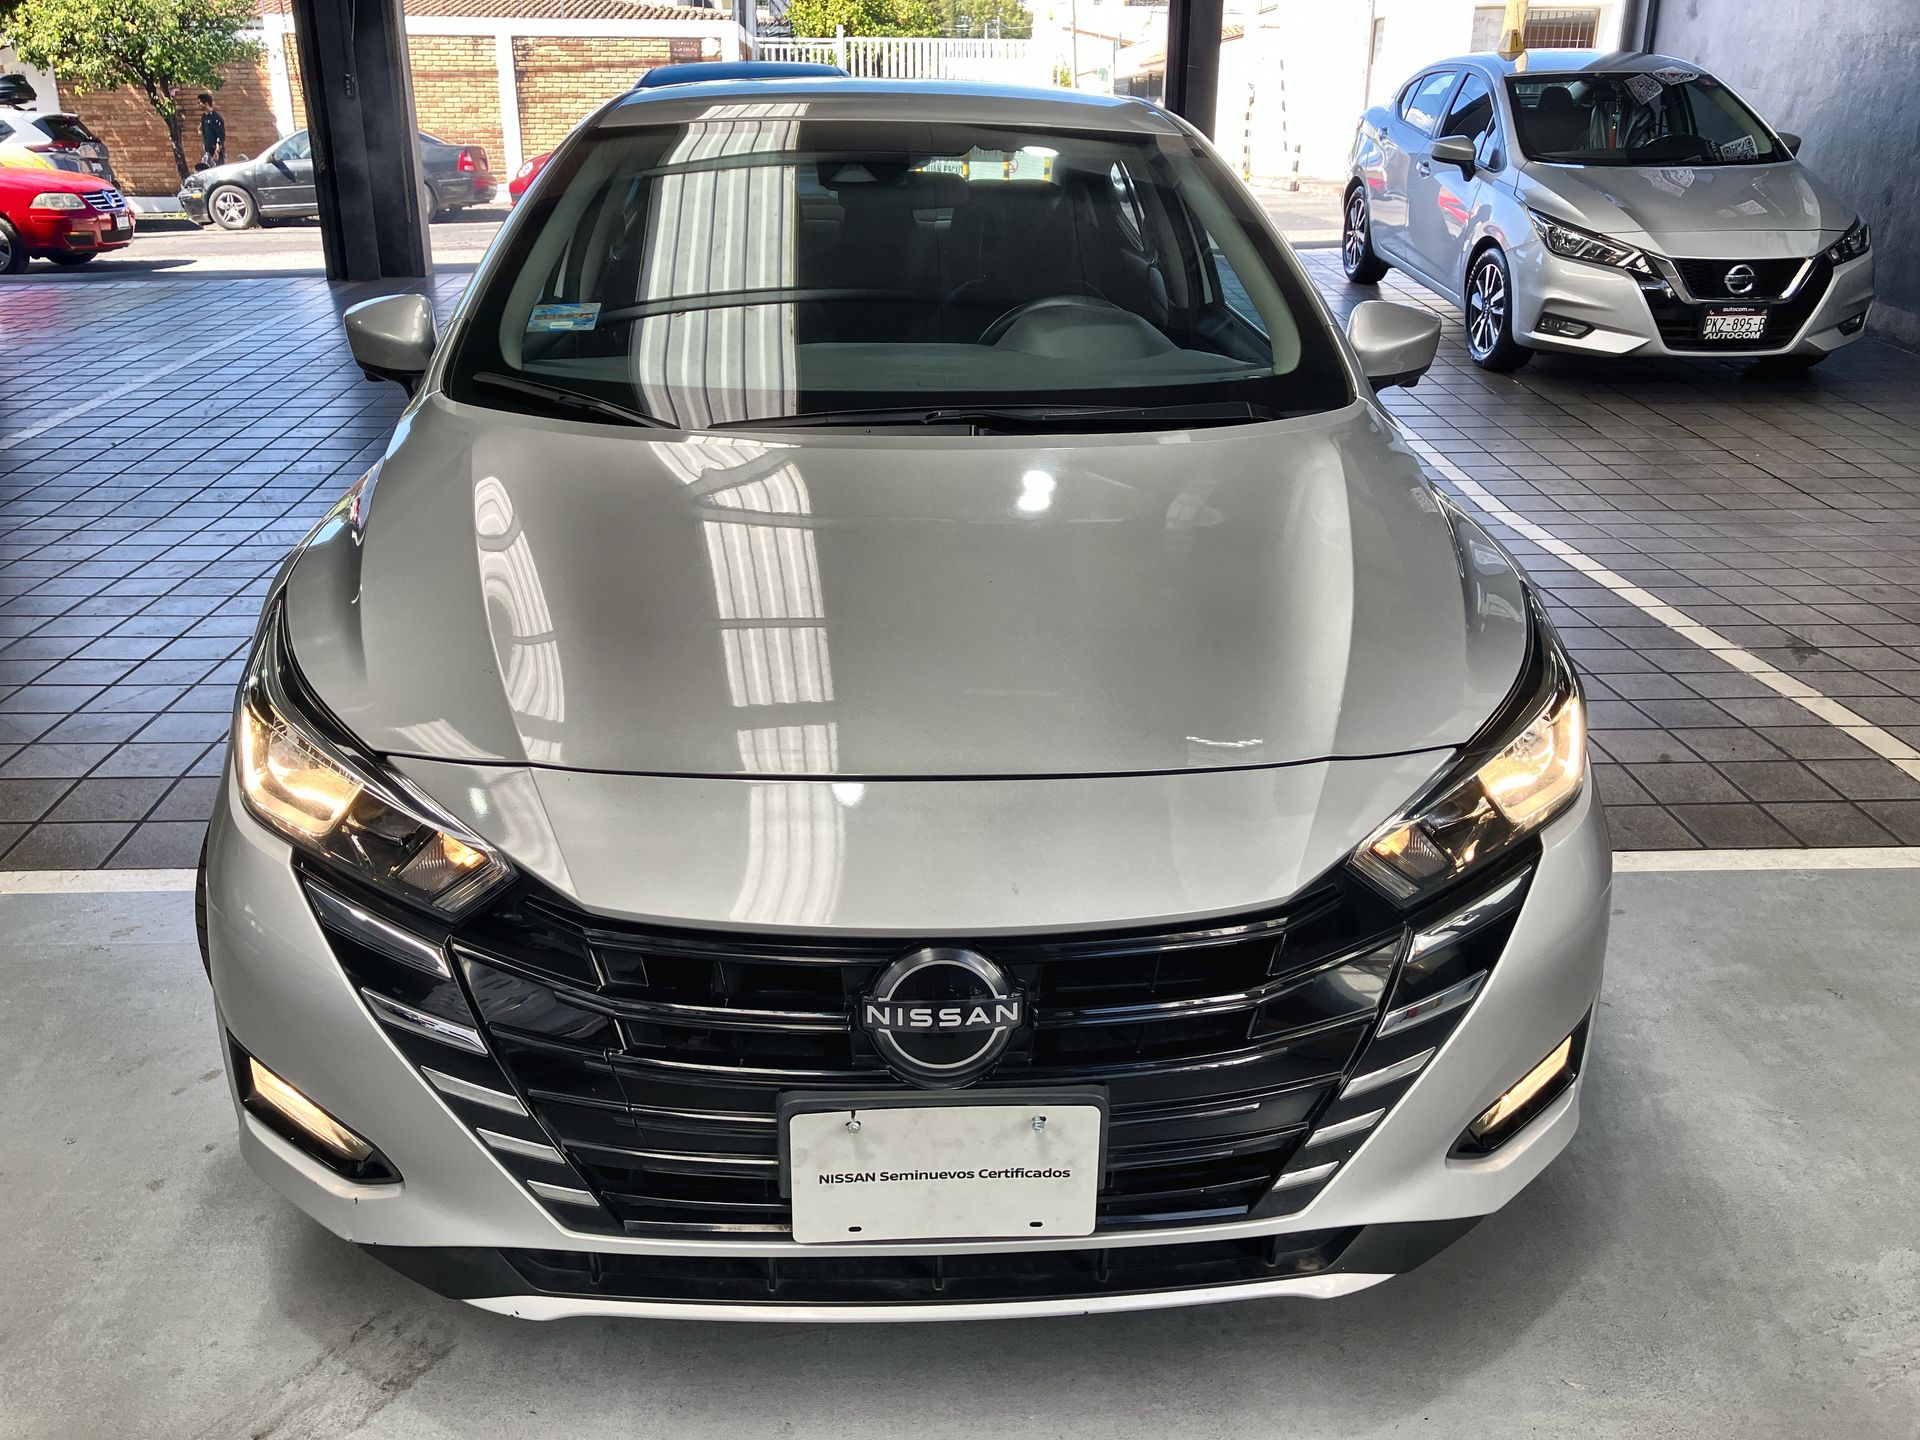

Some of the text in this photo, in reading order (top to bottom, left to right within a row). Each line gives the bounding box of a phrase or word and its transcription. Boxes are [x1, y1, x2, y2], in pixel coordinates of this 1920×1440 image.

[1704, 331, 1761, 340] AUTOCOM
[865, 1001, 1020, 1028] NISSAN
[818, 1167, 1071, 1185] NISSAN Seminuevos Certificados
